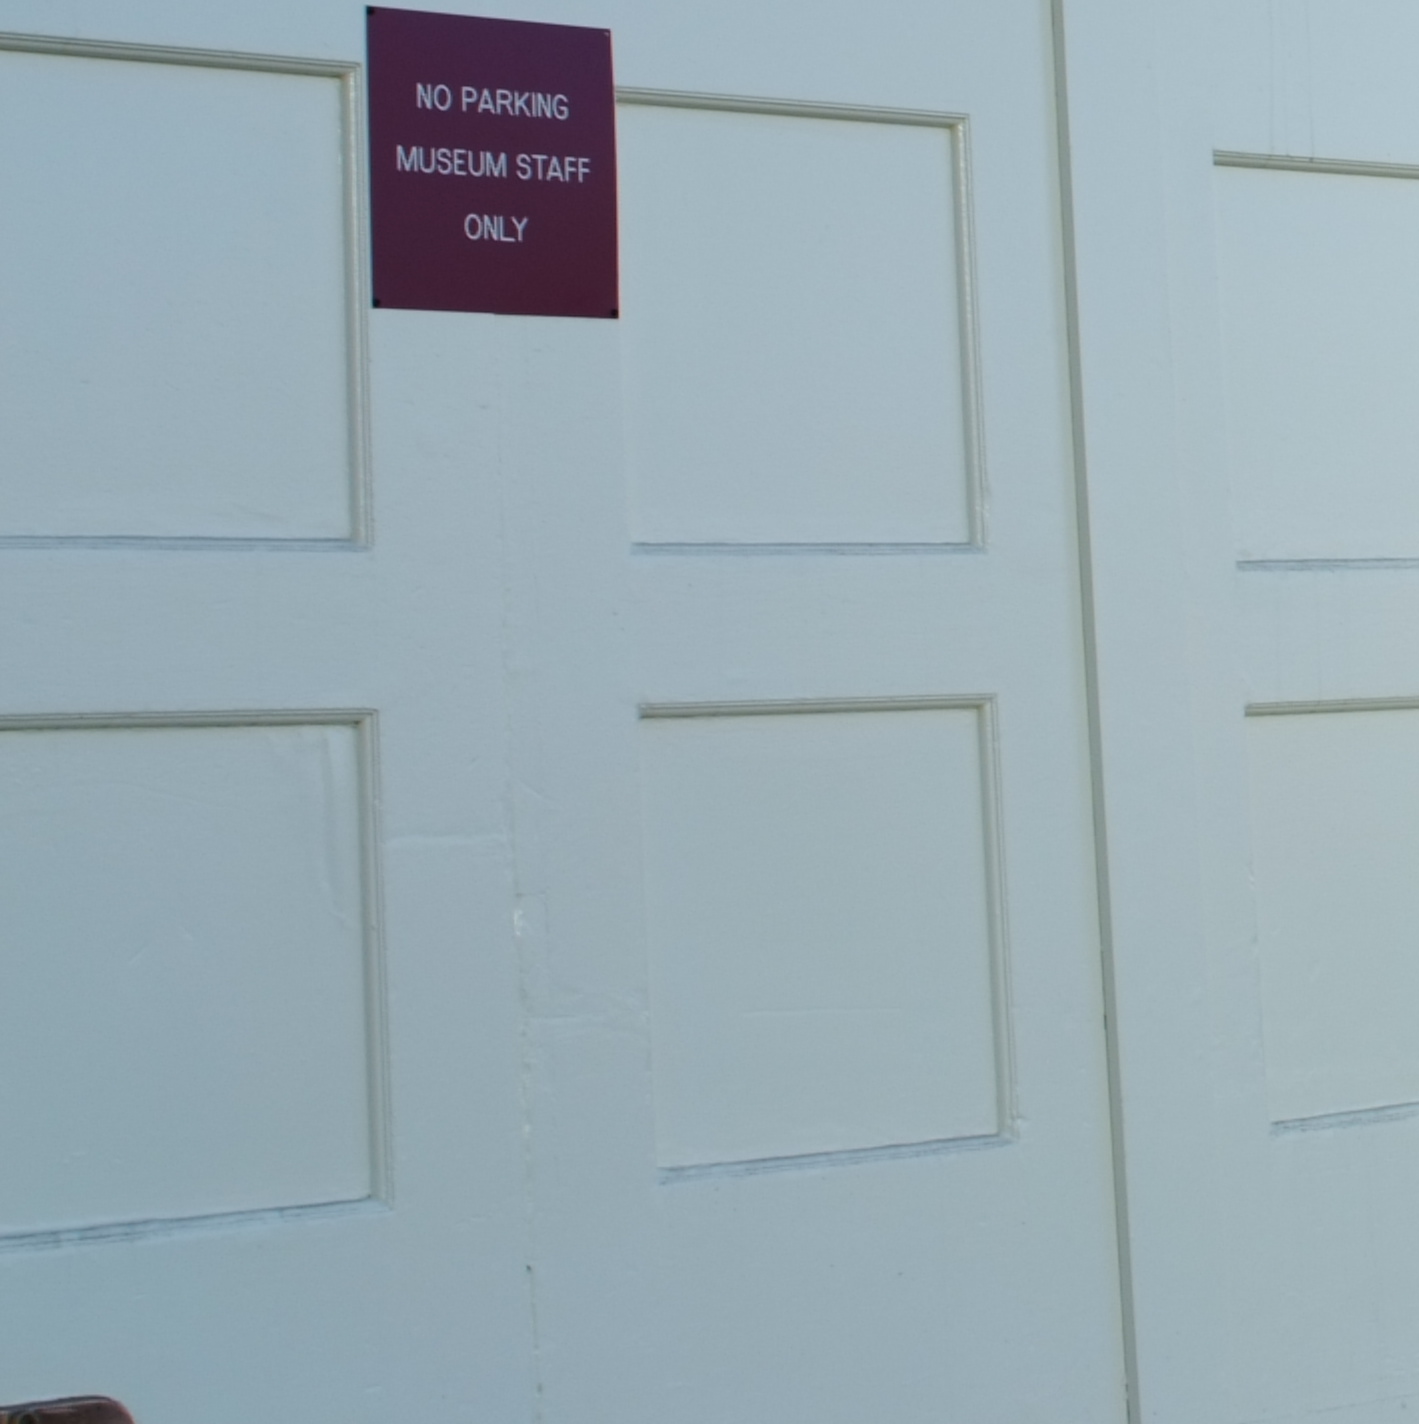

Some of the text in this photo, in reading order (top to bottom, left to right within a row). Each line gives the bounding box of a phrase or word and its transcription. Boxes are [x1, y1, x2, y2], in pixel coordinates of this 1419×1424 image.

[416, 83, 569, 120] NO PARKING
[396, 144, 590, 183] MUSEUM STAFF
[464, 213, 528, 243] ONLY
